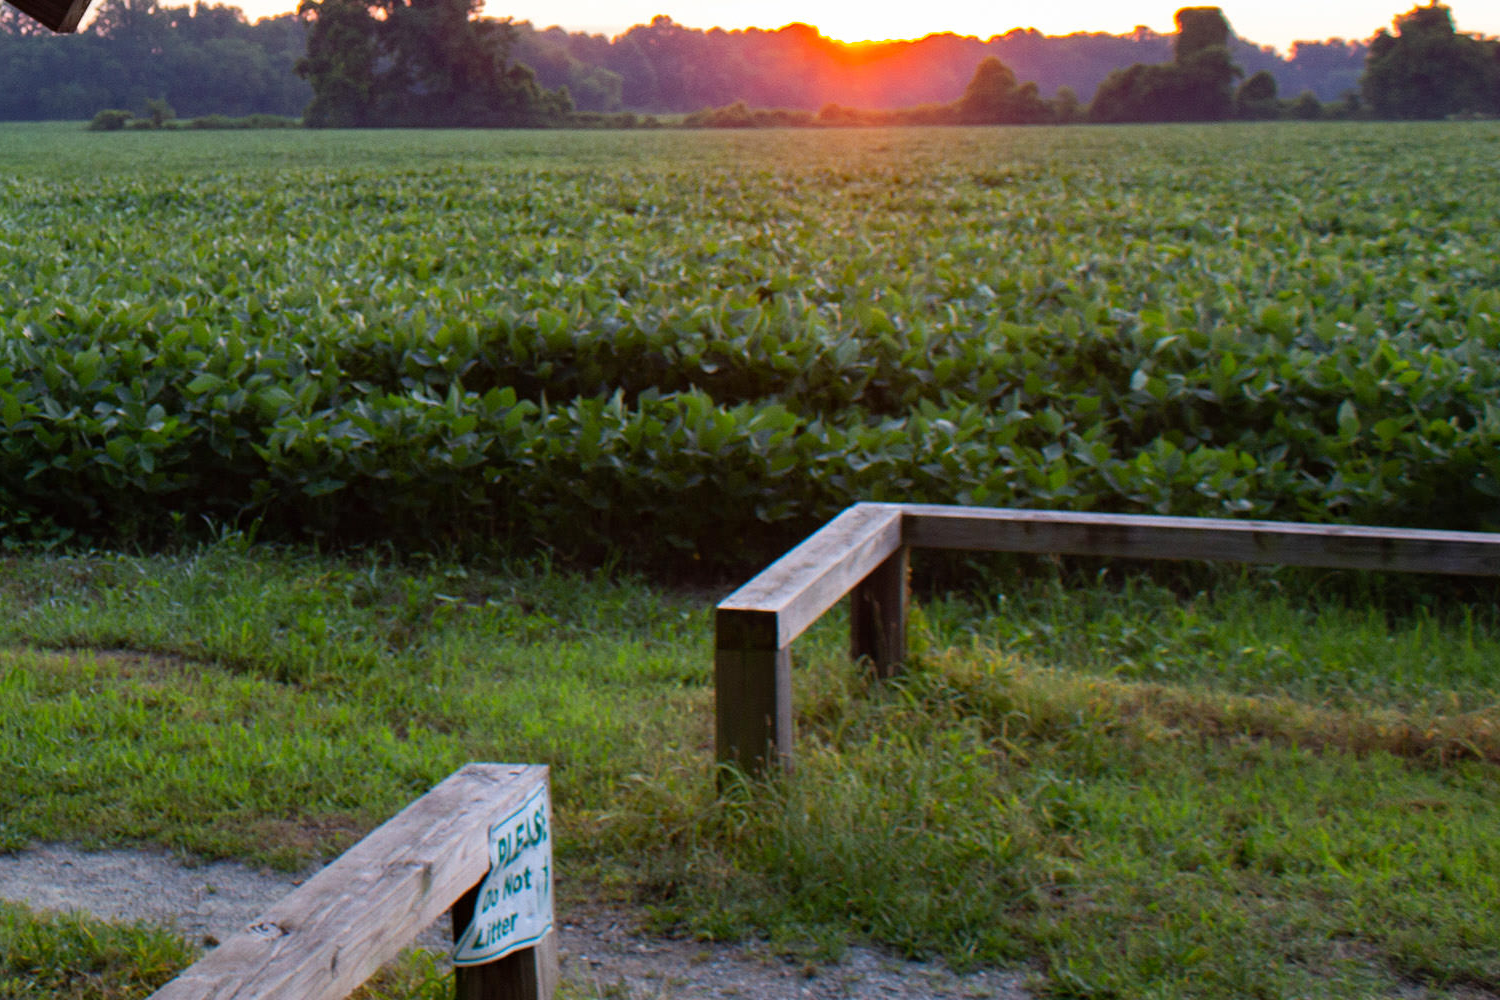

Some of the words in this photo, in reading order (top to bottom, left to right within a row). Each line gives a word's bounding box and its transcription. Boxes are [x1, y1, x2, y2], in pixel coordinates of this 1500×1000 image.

[482, 888, 499, 914] Do
[503, 866, 531, 901] Not
[472, 912, 518, 949] Litter
